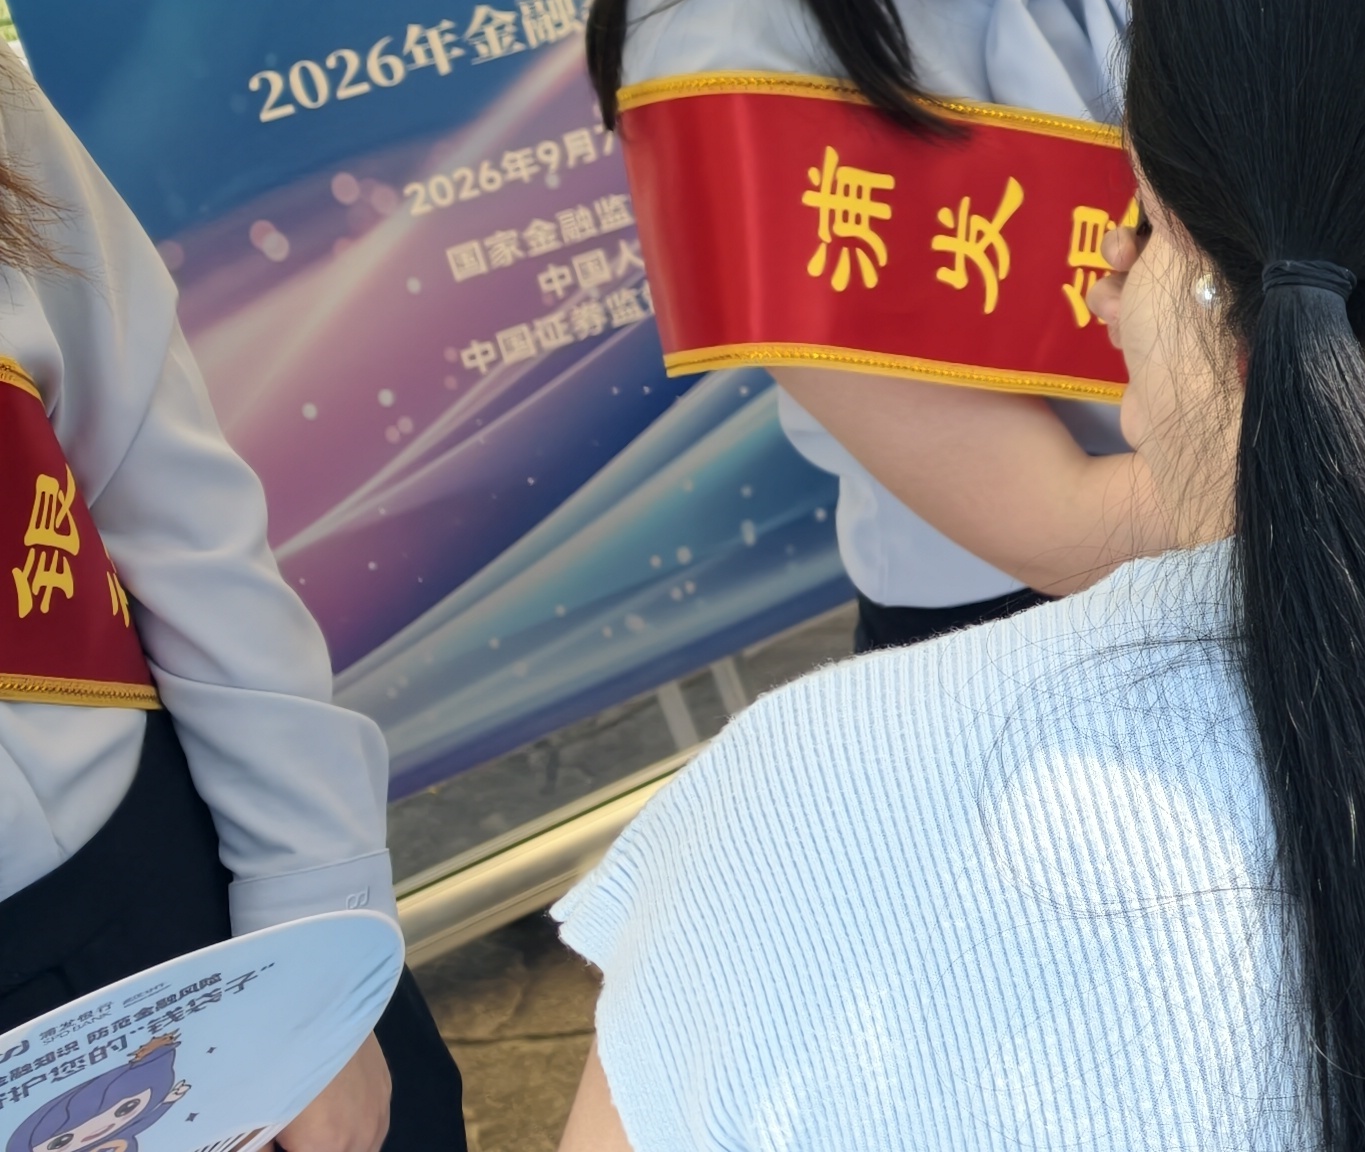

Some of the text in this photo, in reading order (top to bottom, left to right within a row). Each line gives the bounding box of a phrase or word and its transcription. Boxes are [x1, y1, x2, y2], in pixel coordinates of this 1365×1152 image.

[460, 280, 655, 375] 中国证券监
[0, 962, 276, 1110] 护您的“钱袋子”
[38, 1001, 114, 1041] 浦发银行
[87, 972, 223, 1045] 防范金融风险
